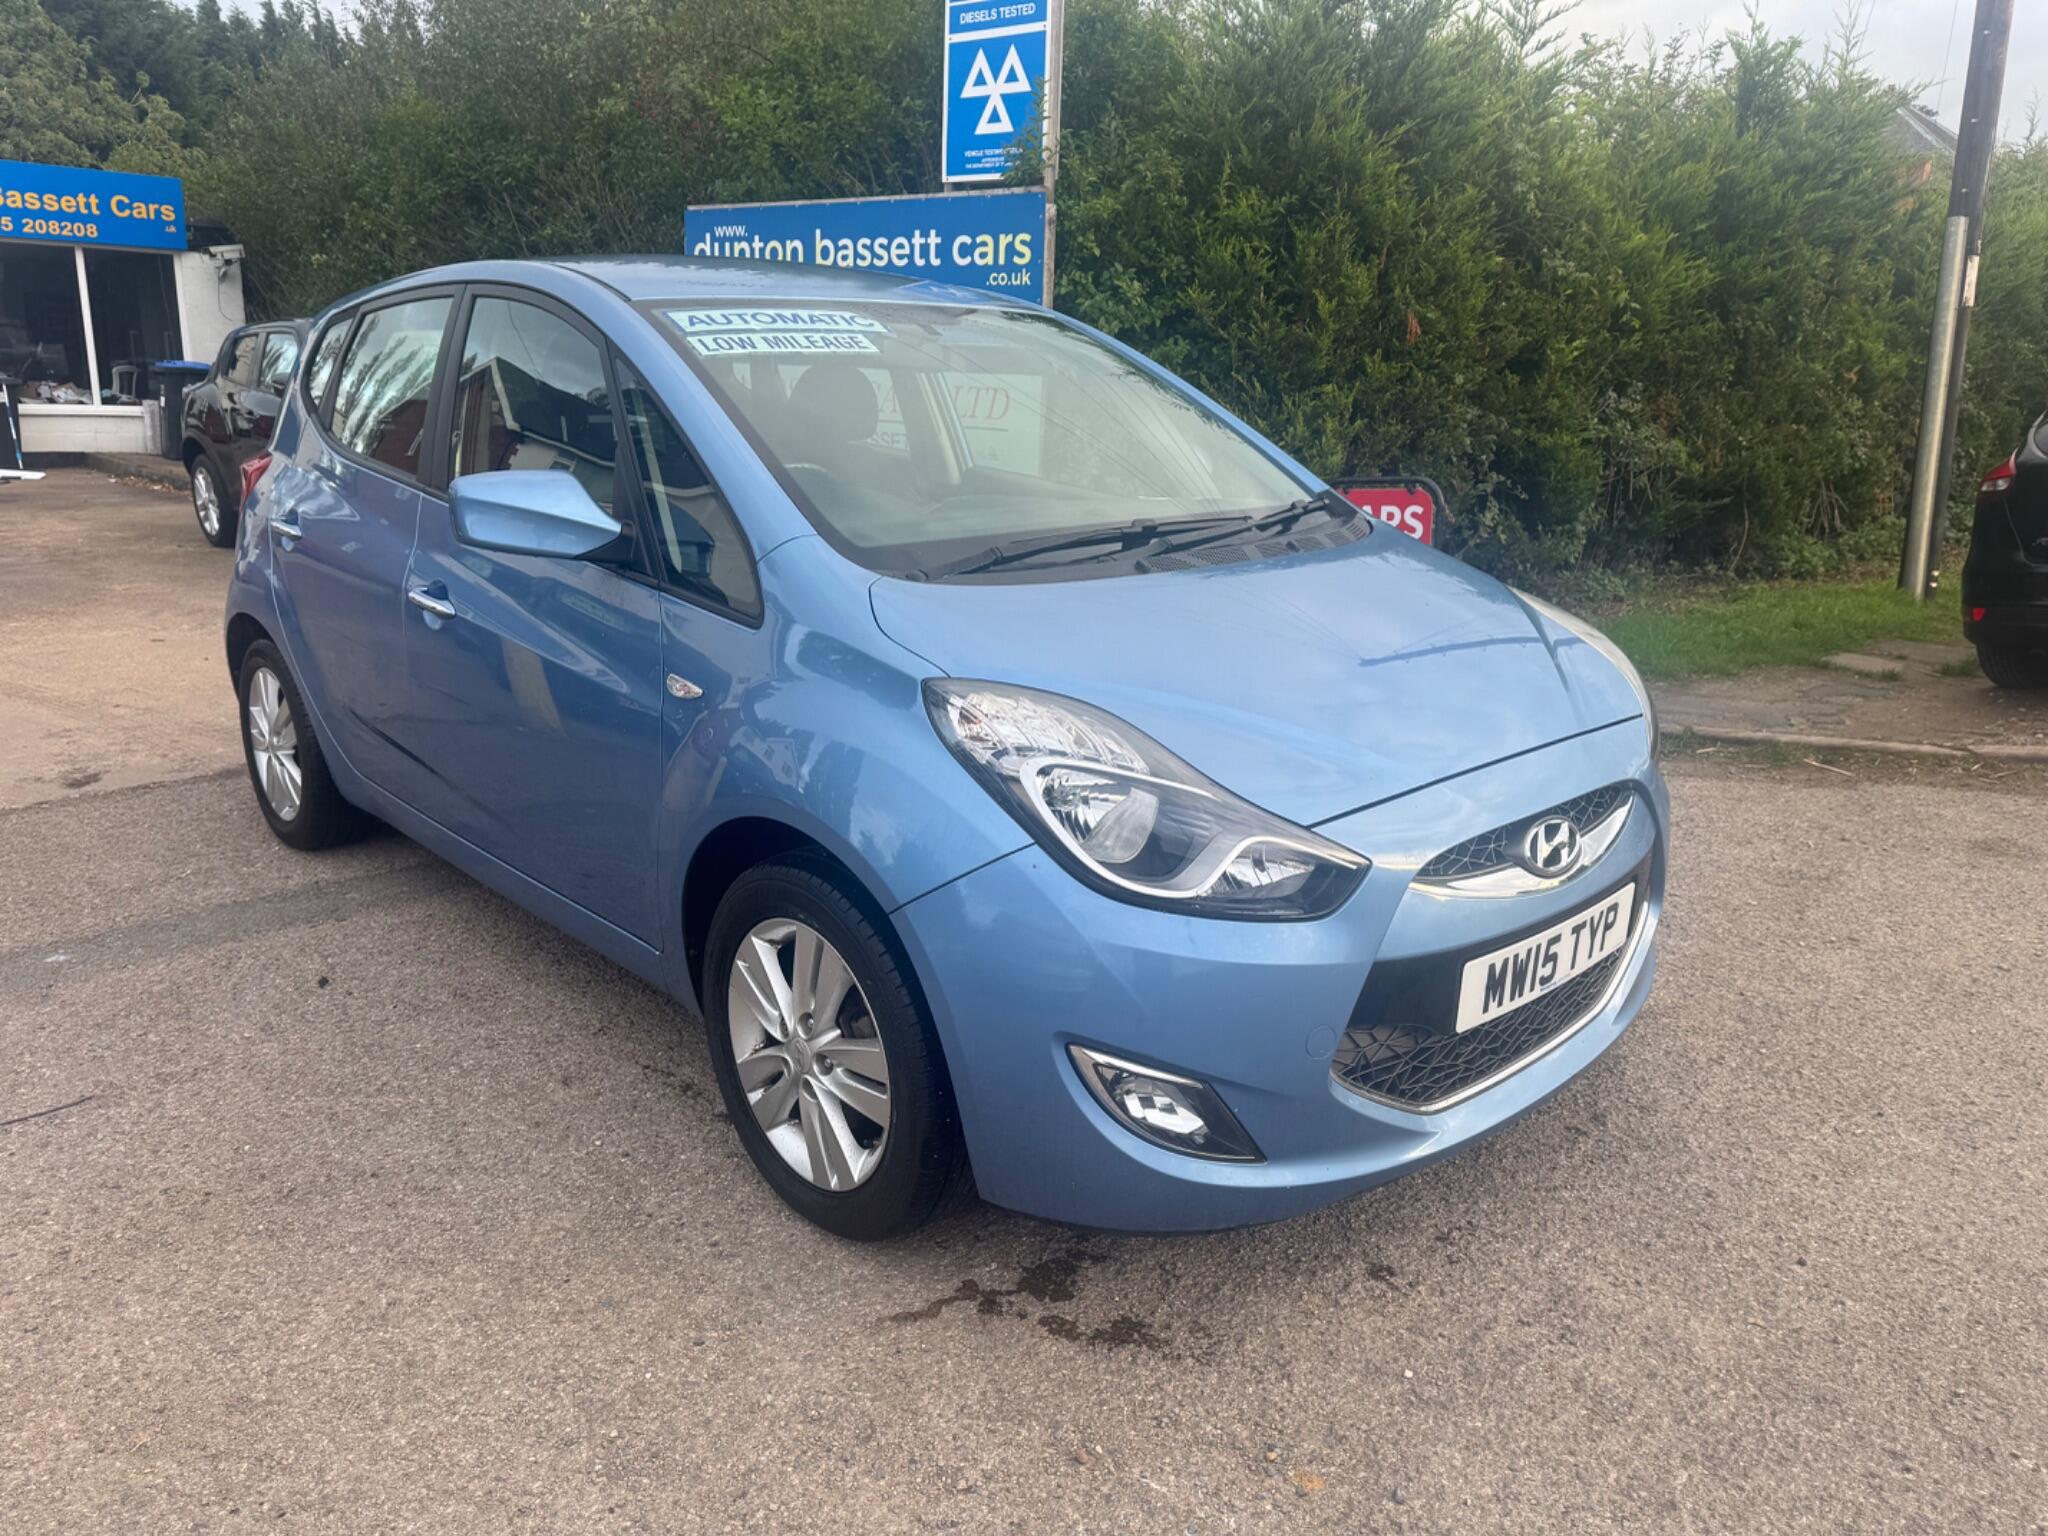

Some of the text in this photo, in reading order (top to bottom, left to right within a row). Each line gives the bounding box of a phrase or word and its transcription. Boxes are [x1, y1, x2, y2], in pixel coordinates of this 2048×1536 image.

[960, 2, 1036, 24] DIESELS TESTED
[0, 186, 176, 221] assett Cars
[22, 218, 98, 238] 208208
[713, 225, 748, 238] www.
[815, 228, 941, 268] bassett
[952, 231, 1032, 267] cars
[986, 269, 1031, 286] .co.uk
[687, 311, 876, 328] AUTOMATIC
[697, 335, 869, 352] LOW MILEAGE
[1482, 902, 1619, 1015] MW15 TYP
